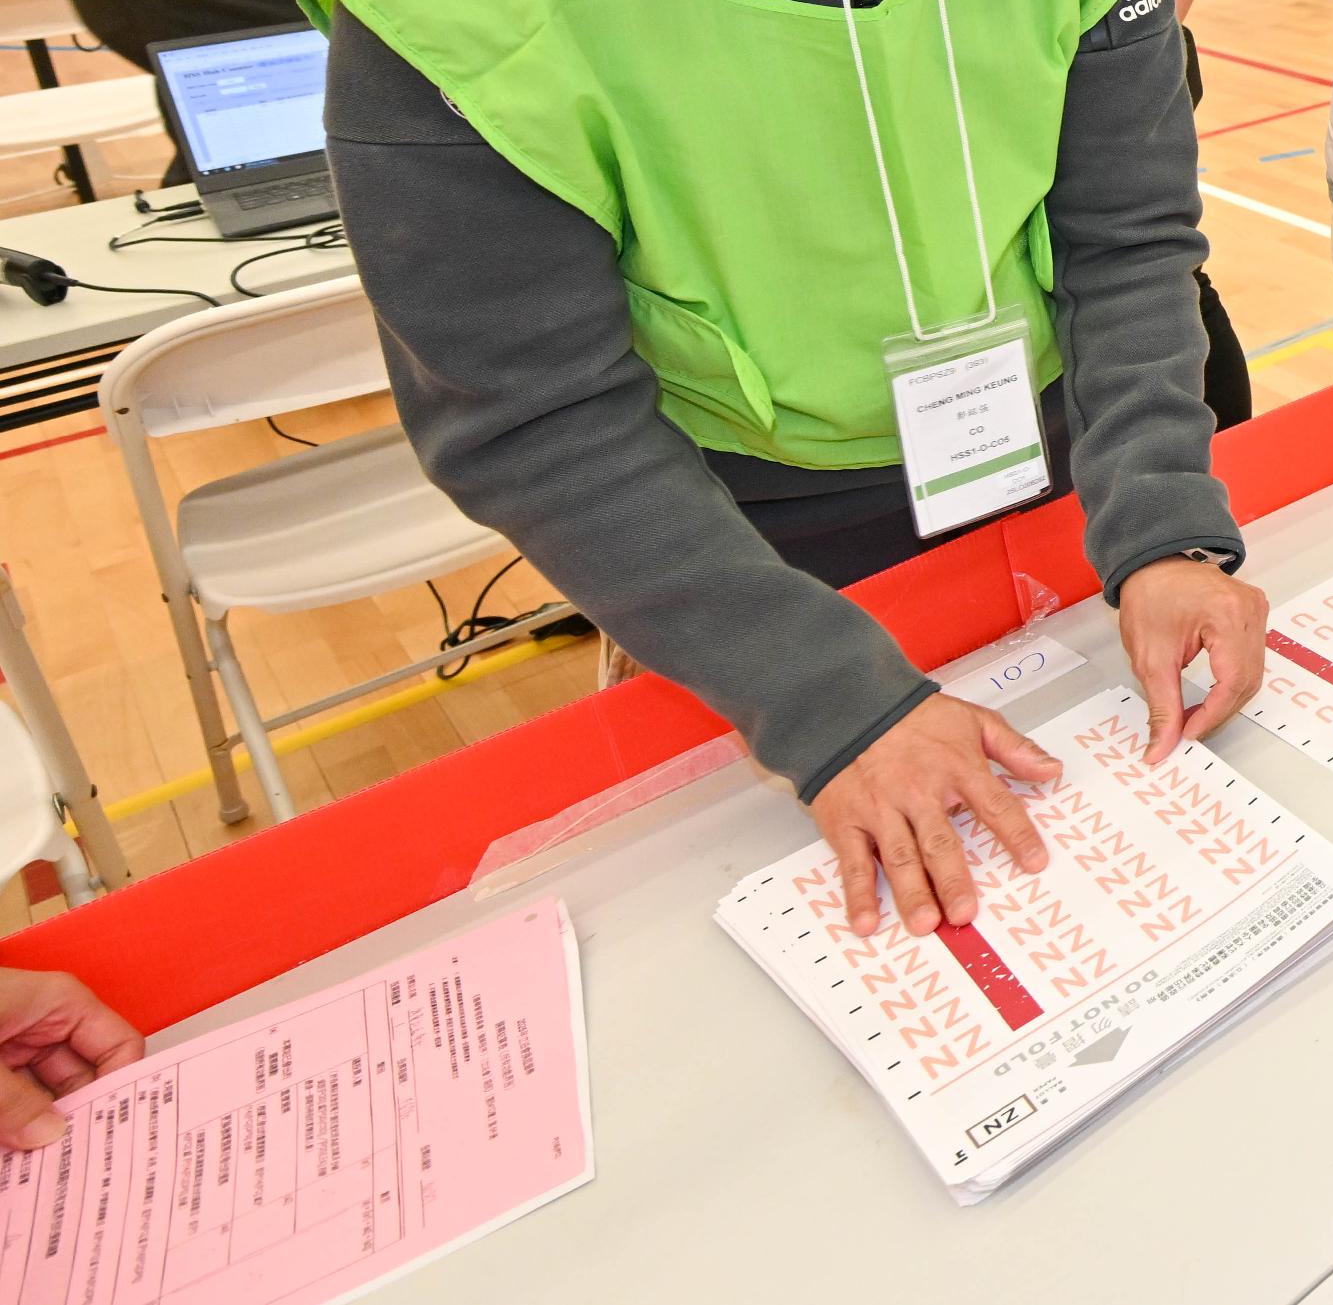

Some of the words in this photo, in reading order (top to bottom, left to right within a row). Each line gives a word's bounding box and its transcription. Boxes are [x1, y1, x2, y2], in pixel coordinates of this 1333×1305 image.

[916, 396, 954, 413] CHENG
[956, 386, 981, 400] MING
[984, 375, 1018, 391] KEUNG
[1289, 612, 1317, 629] U
[1267, 677, 1295, 695] U
[1290, 690, 1320, 710] U
[1072, 714, 1130, 751] ZN
[1132, 765, 1190, 806] ZN
[1153, 781, 1213, 825] ZN
[1034, 791, 1092, 828] ZN
[1051, 810, 1112, 850] ZN
[1175, 799, 1232, 847] ZN
[1073, 830, 1135, 872] ZN
[1198, 818, 1255, 865] ZN
[1221, 836, 1278, 885] ZN
[1093, 851, 1157, 896] ZN
[987, 878, 1050, 921] ZN
[1116, 873, 1180, 919] ZN
[1007, 899, 1071, 946] ZN
[1139, 895, 1202, 942] ZN
[858, 945, 929, 996] ZN
[1028, 923, 1095, 974] ZN
[1050, 947, 1118, 998] ZN
[1130, 969, 1160, 993] DO
[879, 969, 952, 1022] ZN
[1069, 994, 1120, 1033] NOT
[898, 996, 970, 1050] ZN
[917, 1023, 992, 1080] ZN
[993, 1030, 1061, 1077] FOLD
[983, 1106, 1020, 1136] ZN
